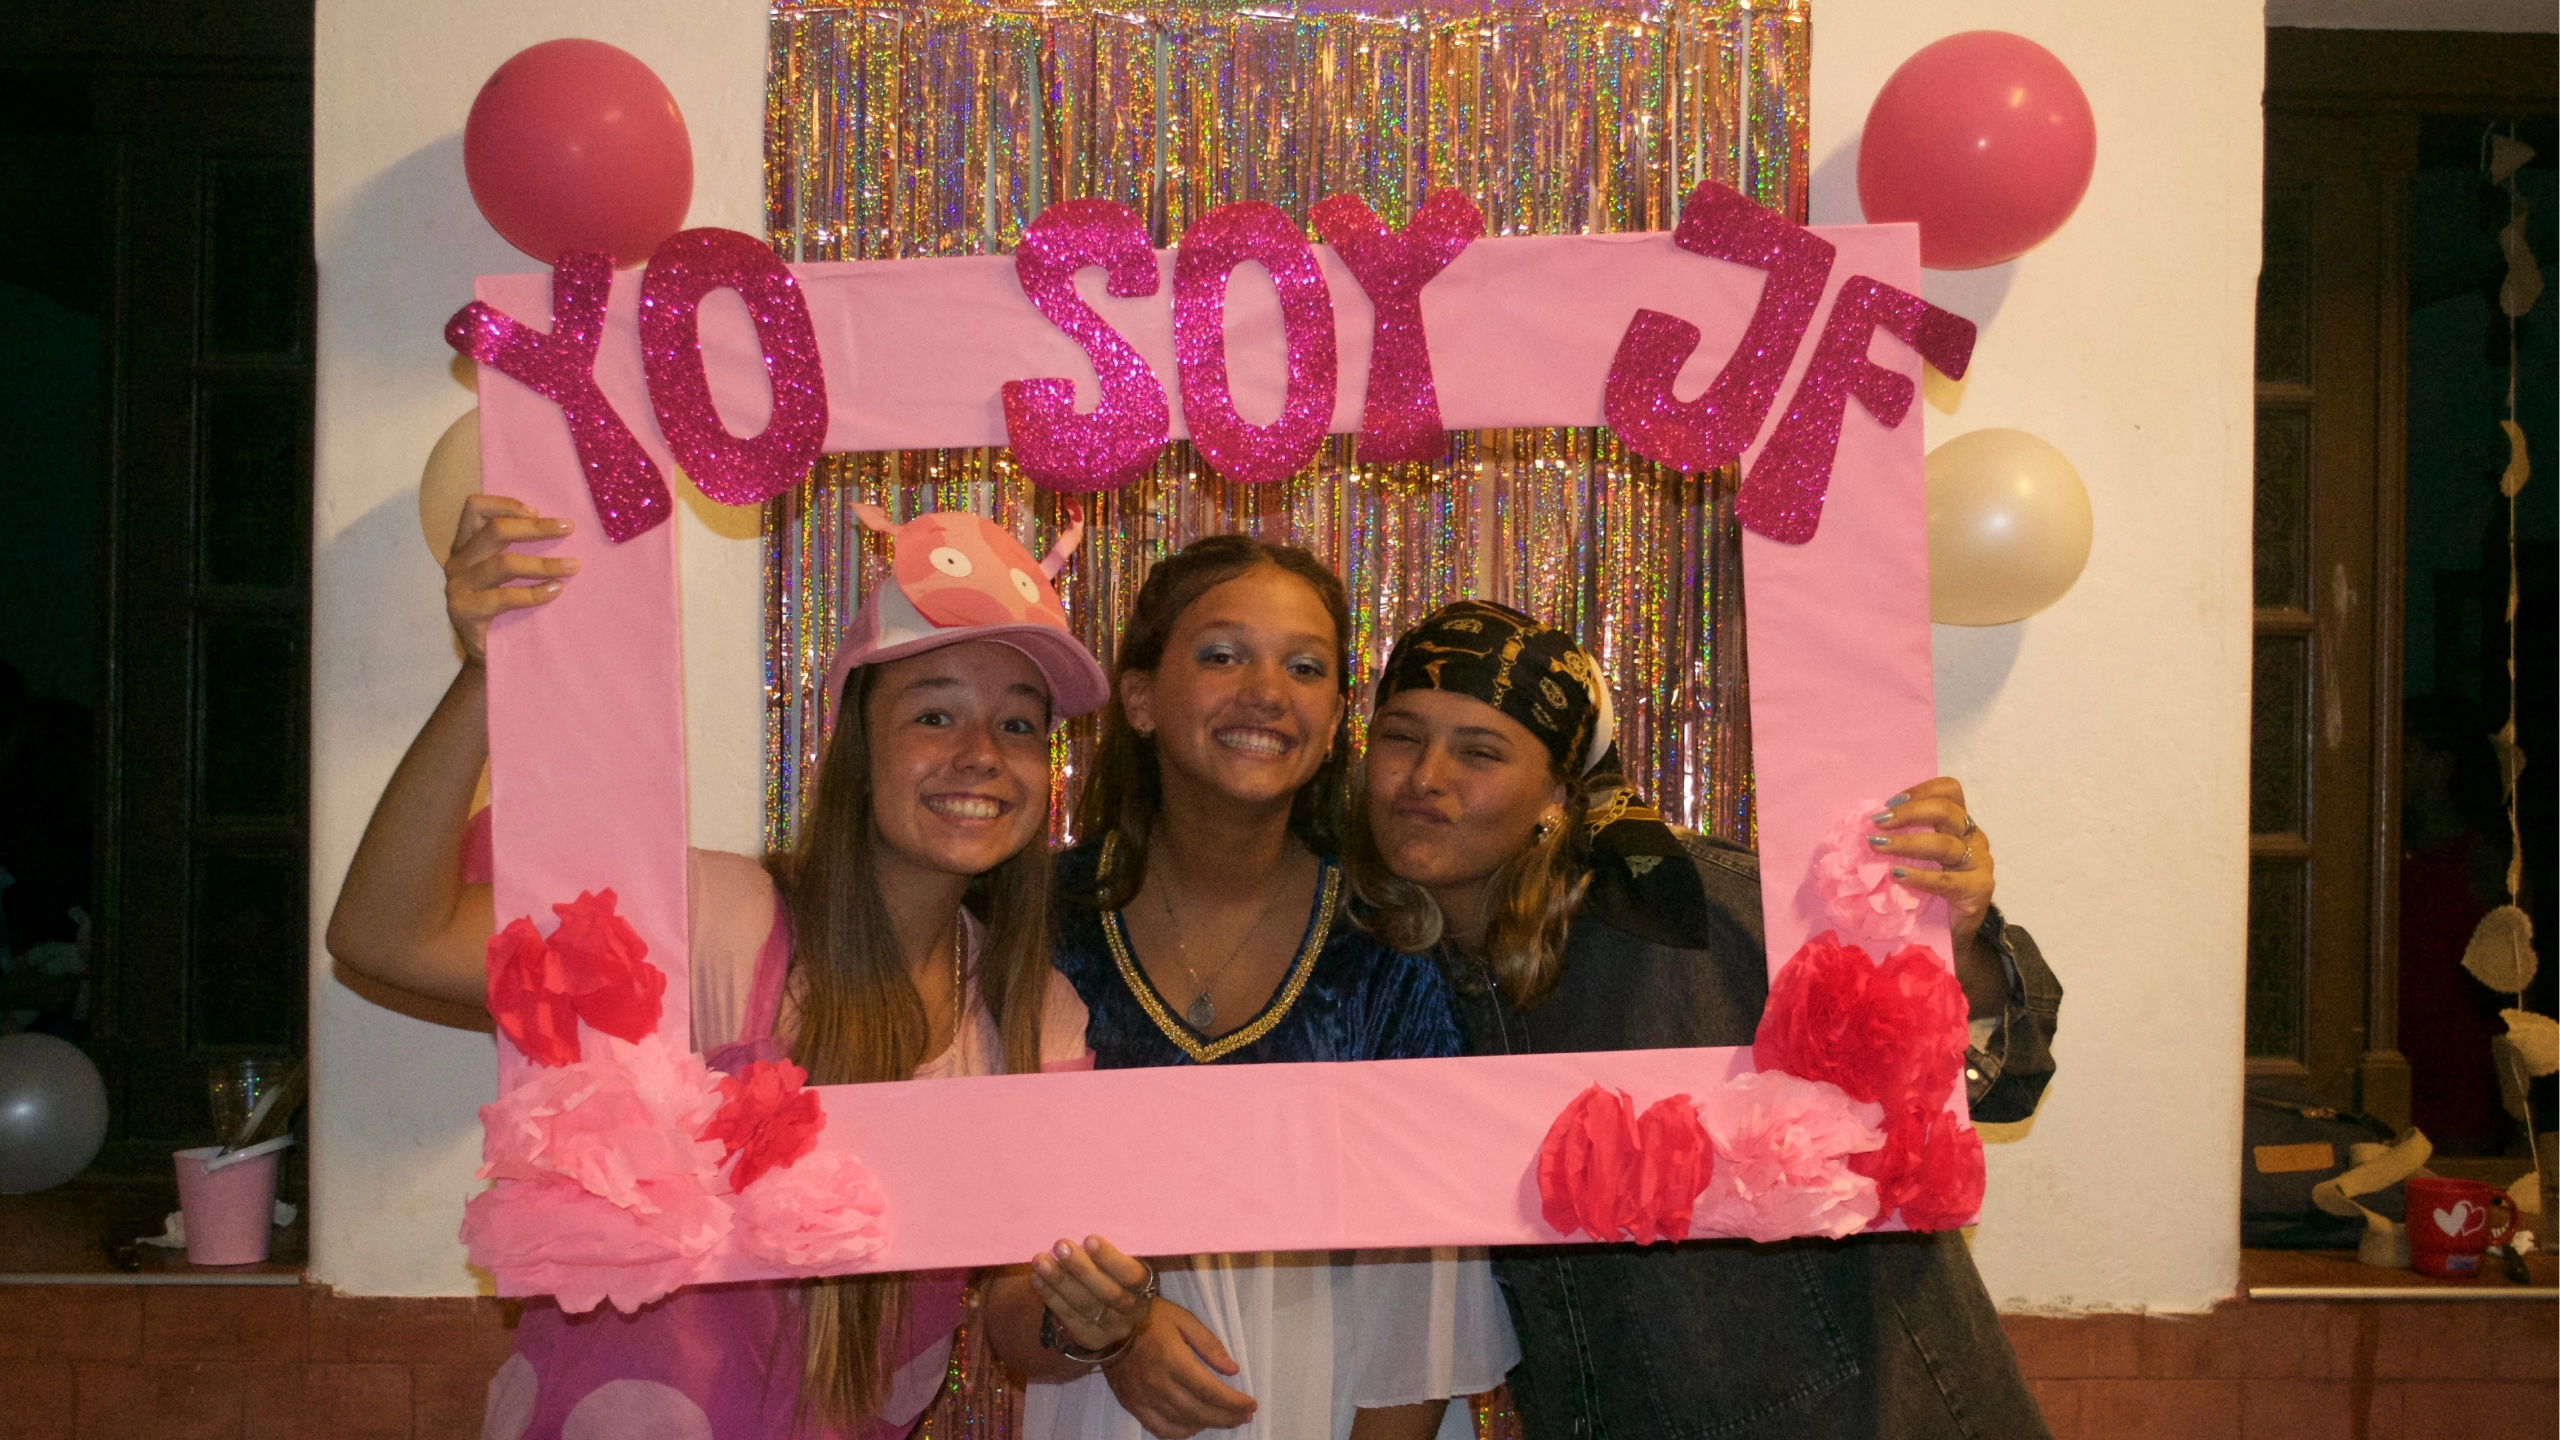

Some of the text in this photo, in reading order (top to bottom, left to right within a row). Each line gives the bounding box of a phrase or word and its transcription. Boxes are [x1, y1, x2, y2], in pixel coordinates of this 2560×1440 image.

[445, 181, 1977, 545] YO SOY JF
